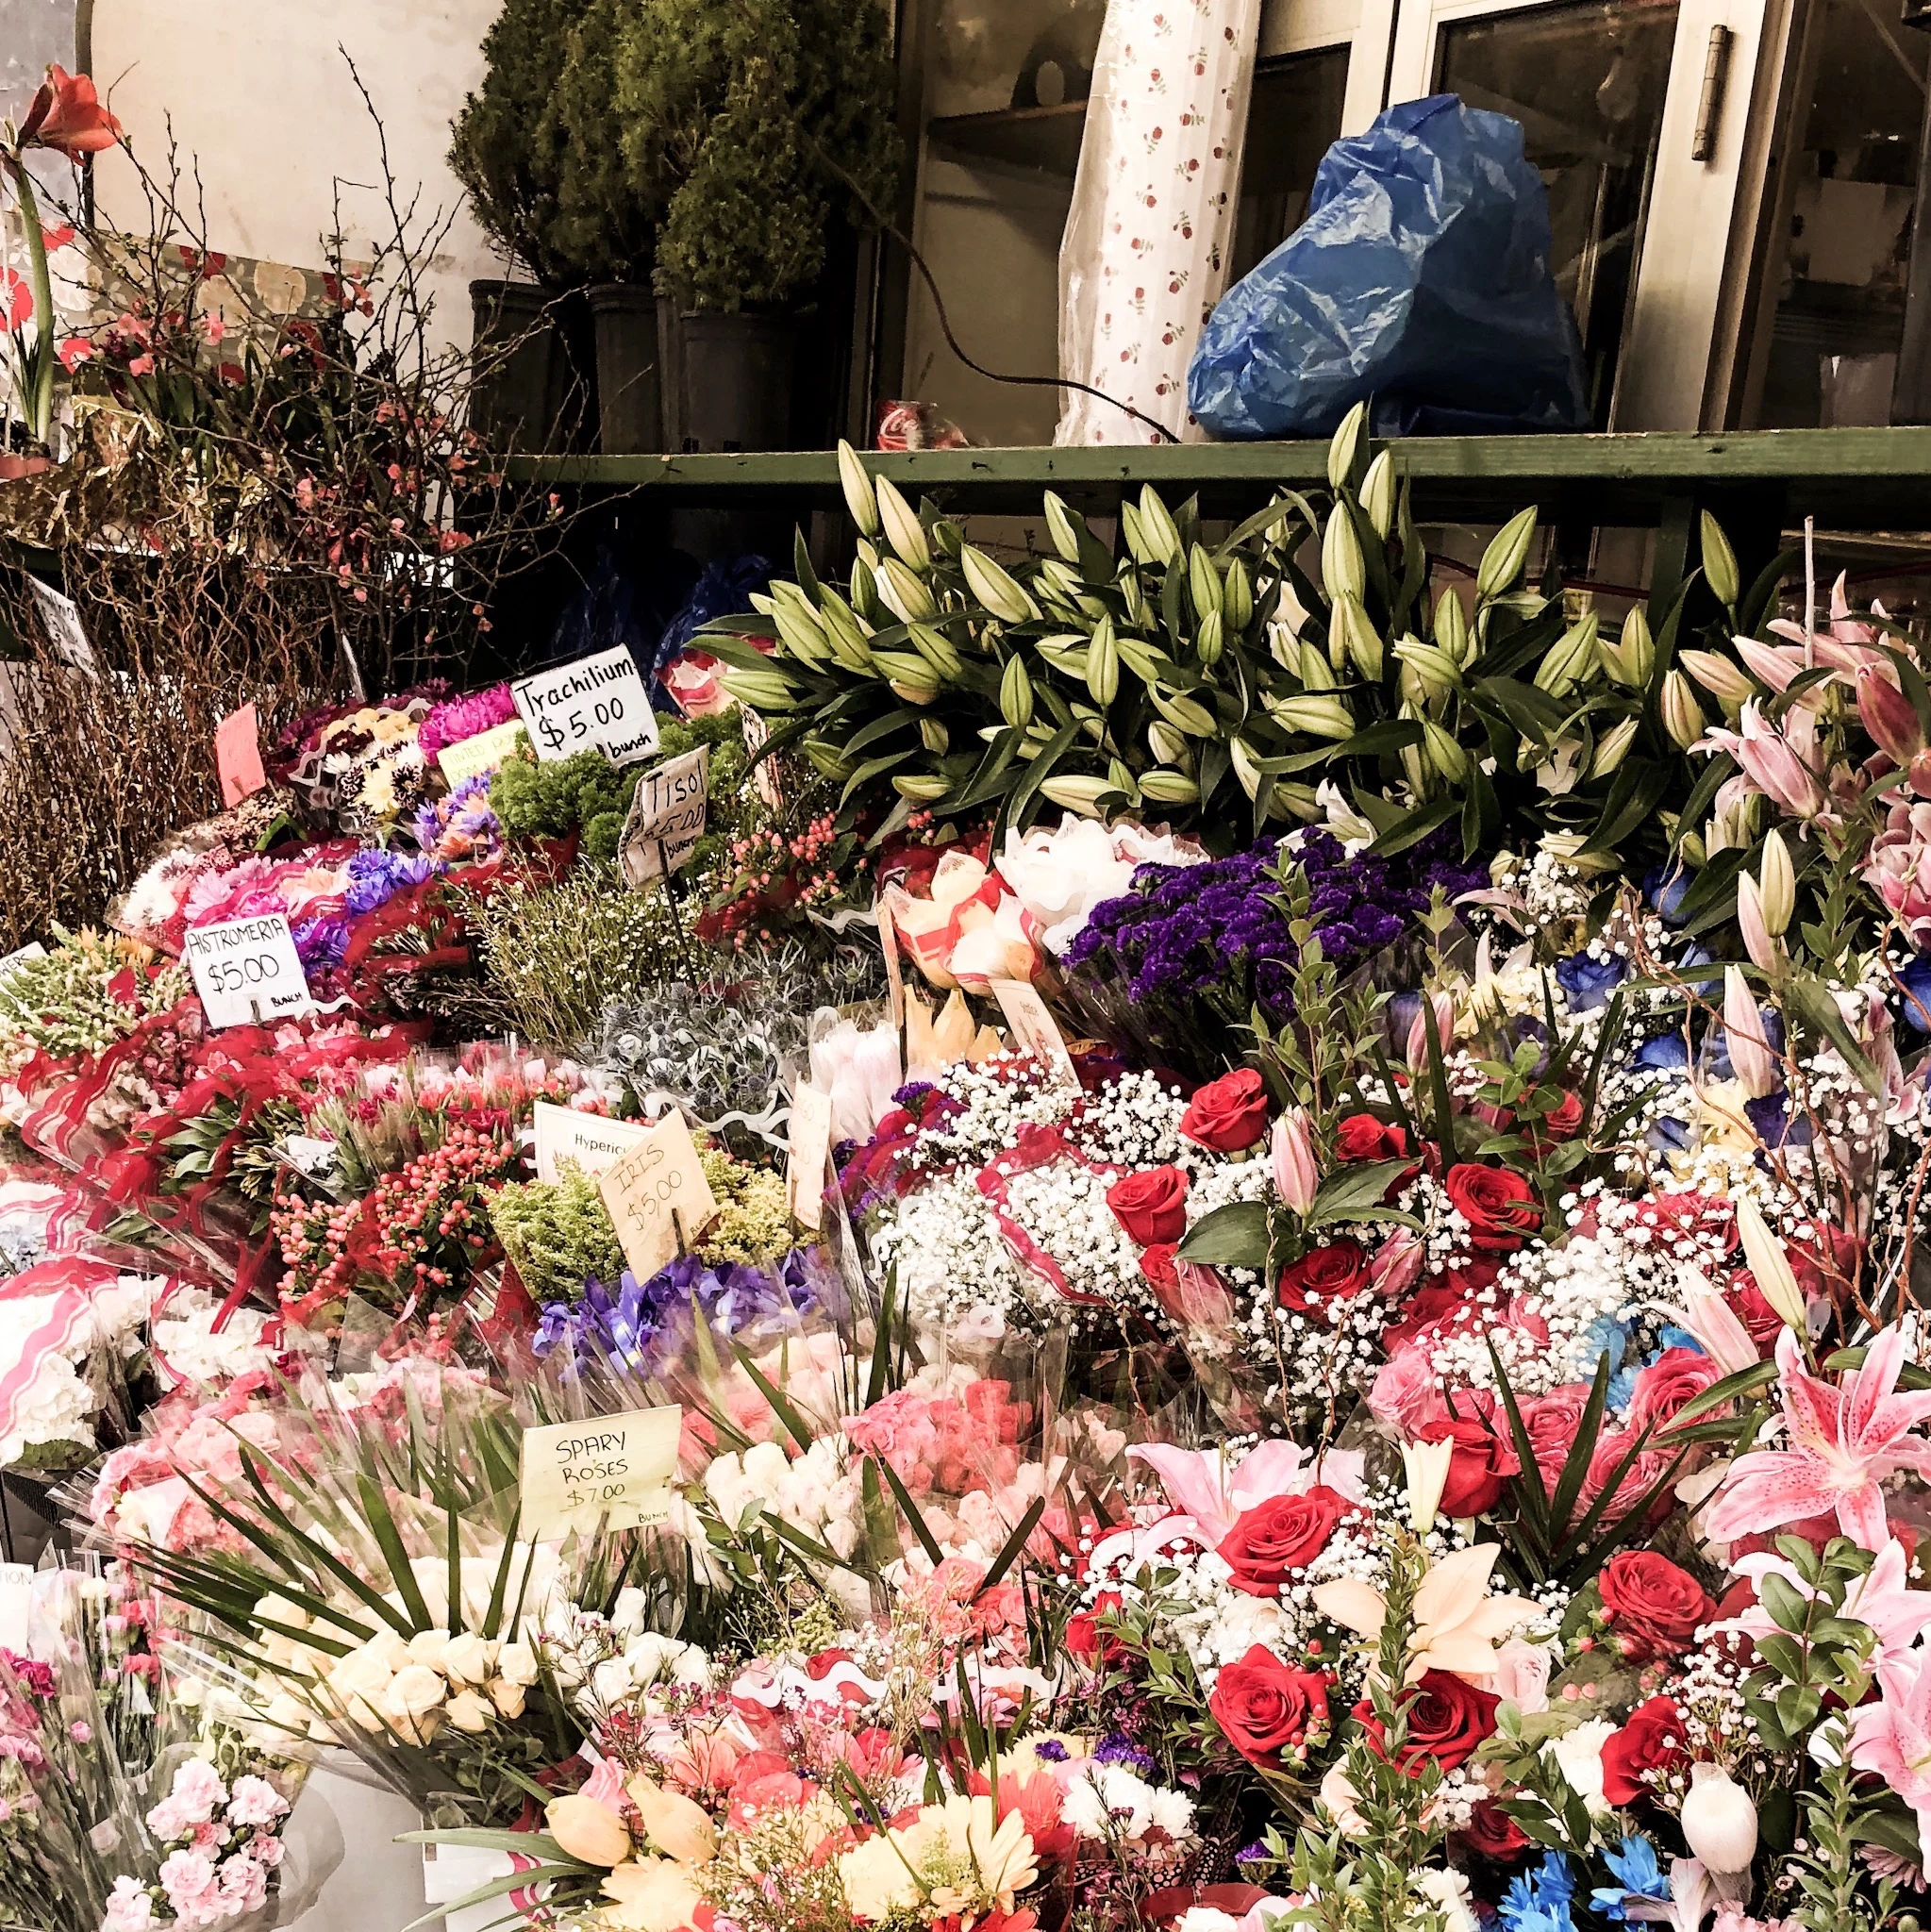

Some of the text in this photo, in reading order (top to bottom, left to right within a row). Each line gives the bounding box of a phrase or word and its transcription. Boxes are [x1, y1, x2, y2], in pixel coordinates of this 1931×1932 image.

[514, 658, 635, 717] Trachilium
[539, 697, 624, 751] $5.00
[608, 733, 652, 758] bunch
[646, 758, 705, 814] Tisol
[208, 954, 280, 995] $5.00
[270, 991, 304, 1008] BUNCH
[614, 1143, 665, 1195] IRIS
[556, 1431, 625, 1464] SPARY
[562, 1458, 628, 1484] ROSES
[638, 1510, 669, 1524] BUNCH
